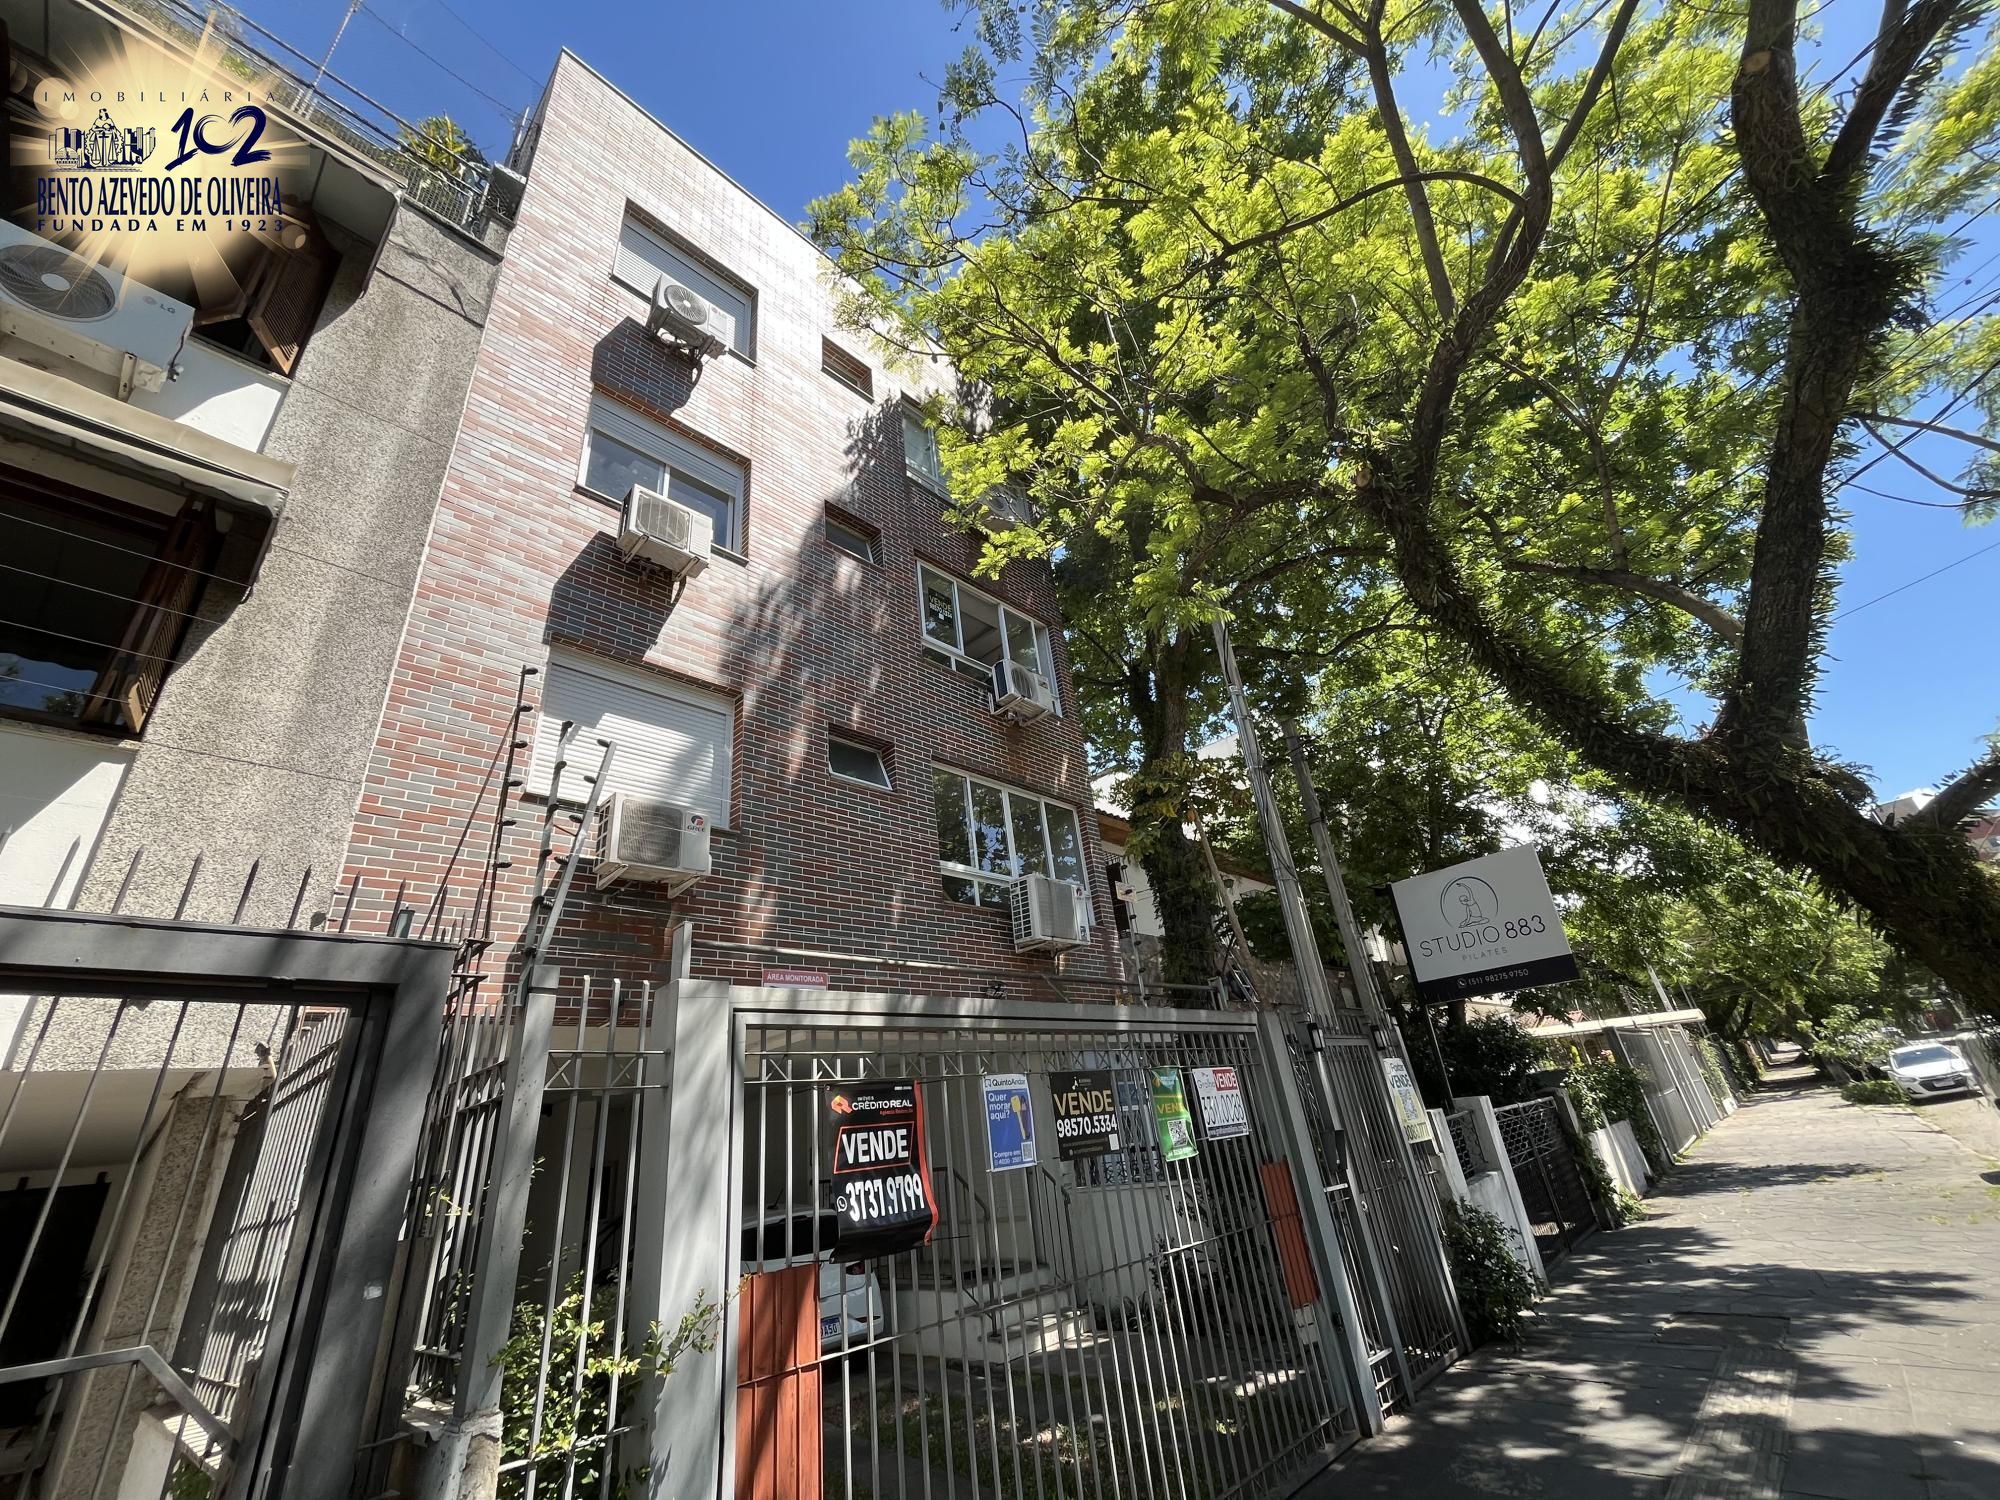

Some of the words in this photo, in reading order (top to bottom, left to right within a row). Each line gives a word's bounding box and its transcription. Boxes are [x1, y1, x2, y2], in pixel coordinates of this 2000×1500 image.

[160, 303, 176, 314] LG
[1419, 925, 1500, 958] STUDIO
[1504, 914, 1546, 939] 883
[1462, 946, 1508, 961] PILATES
[766, 972, 784, 981] ÁREA
[785, 974, 824, 983] MONITORADA
[1213, 1072, 1238, 1088] VENDE
[1390, 1073, 1412, 1089] VENDE
[988, 1092, 1007, 1102] Quer
[1053, 1089, 1114, 1116] VENDE
[989, 1101, 1011, 1111] morar
[990, 1110, 1010, 1121] aqui?
[1056, 1113, 1118, 1138] 98570.5334
[841, 1128, 909, 1164] VENDE
[845, 1173, 925, 1222] 3737.9799
